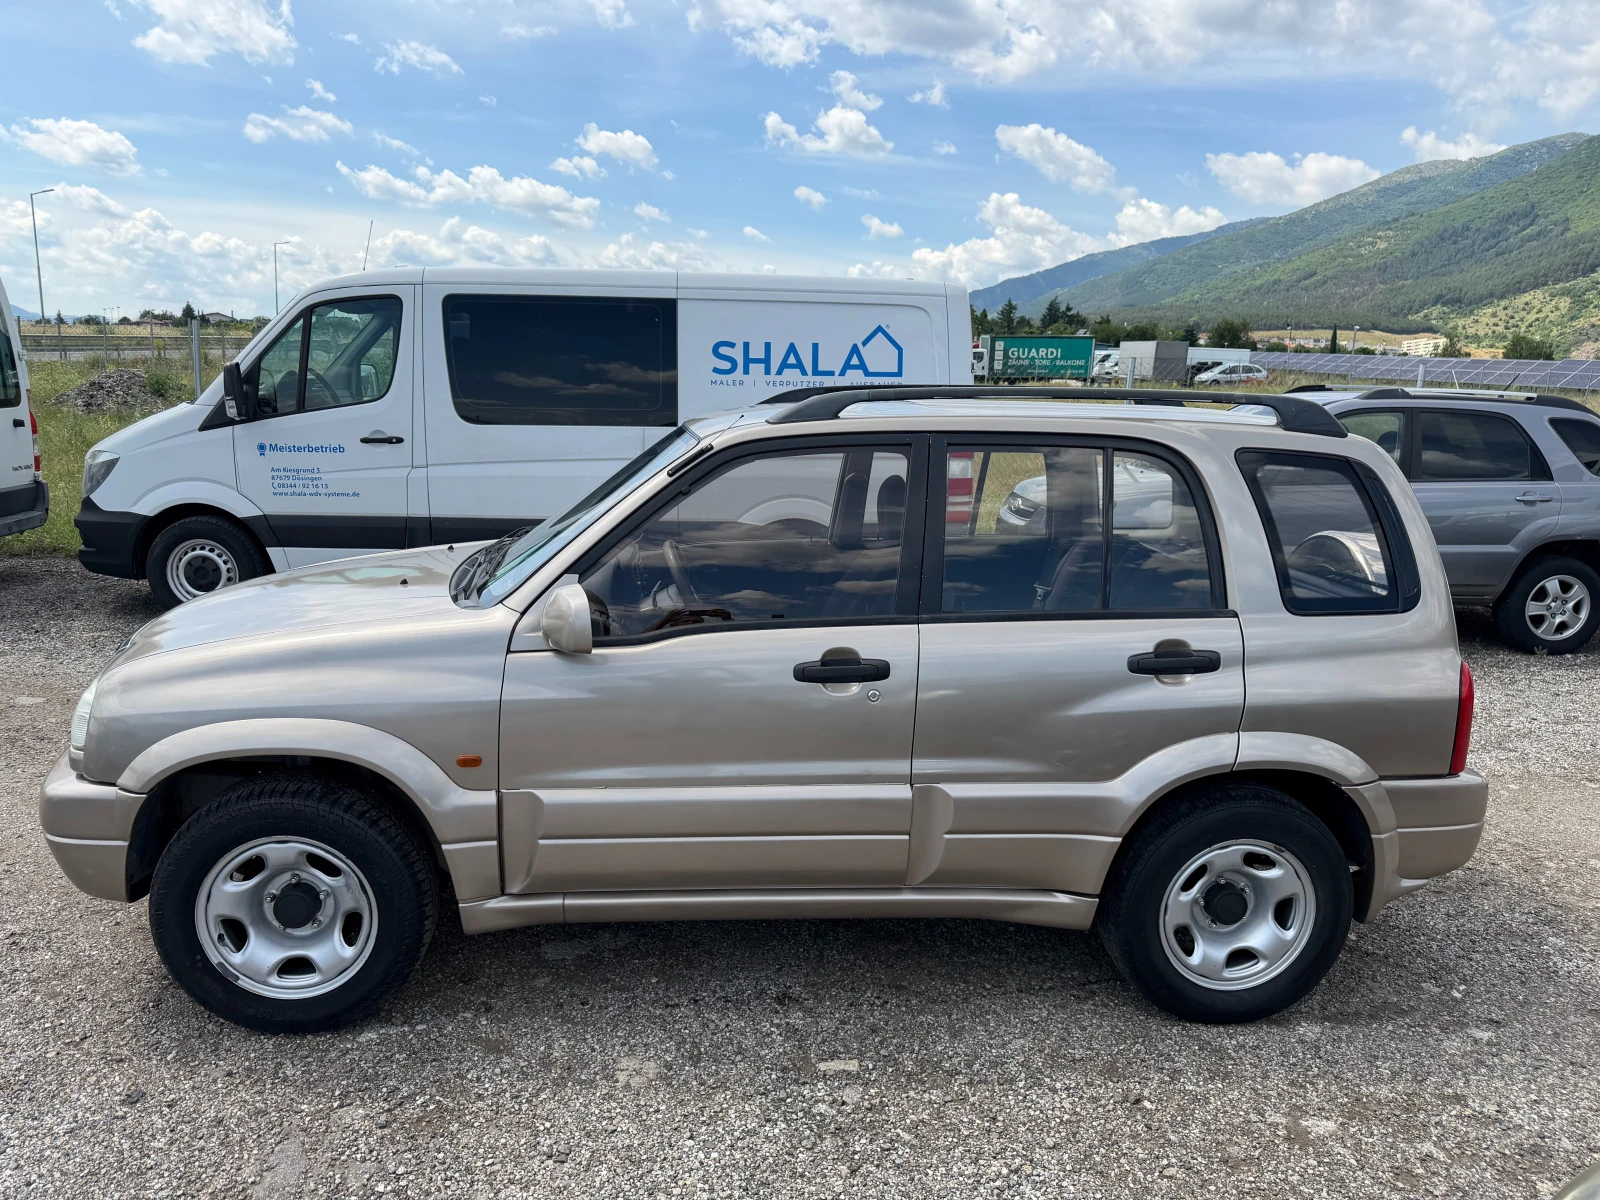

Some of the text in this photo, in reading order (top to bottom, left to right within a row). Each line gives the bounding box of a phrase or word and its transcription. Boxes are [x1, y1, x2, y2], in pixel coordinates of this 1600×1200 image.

[1008, 347, 1061, 359] GUARDI
[711, 340, 870, 377] SHALA
[710, 379, 745, 387] MALER
[765, 380, 825, 388] VERPUTZER
[269, 443, 345, 454] Meisterbetrieb
[282, 467, 315, 475] Kiesgrund
[291, 475, 323, 483] Dösingen
[272, 490, 361, 498] www.shala-wdv-systeme.de
